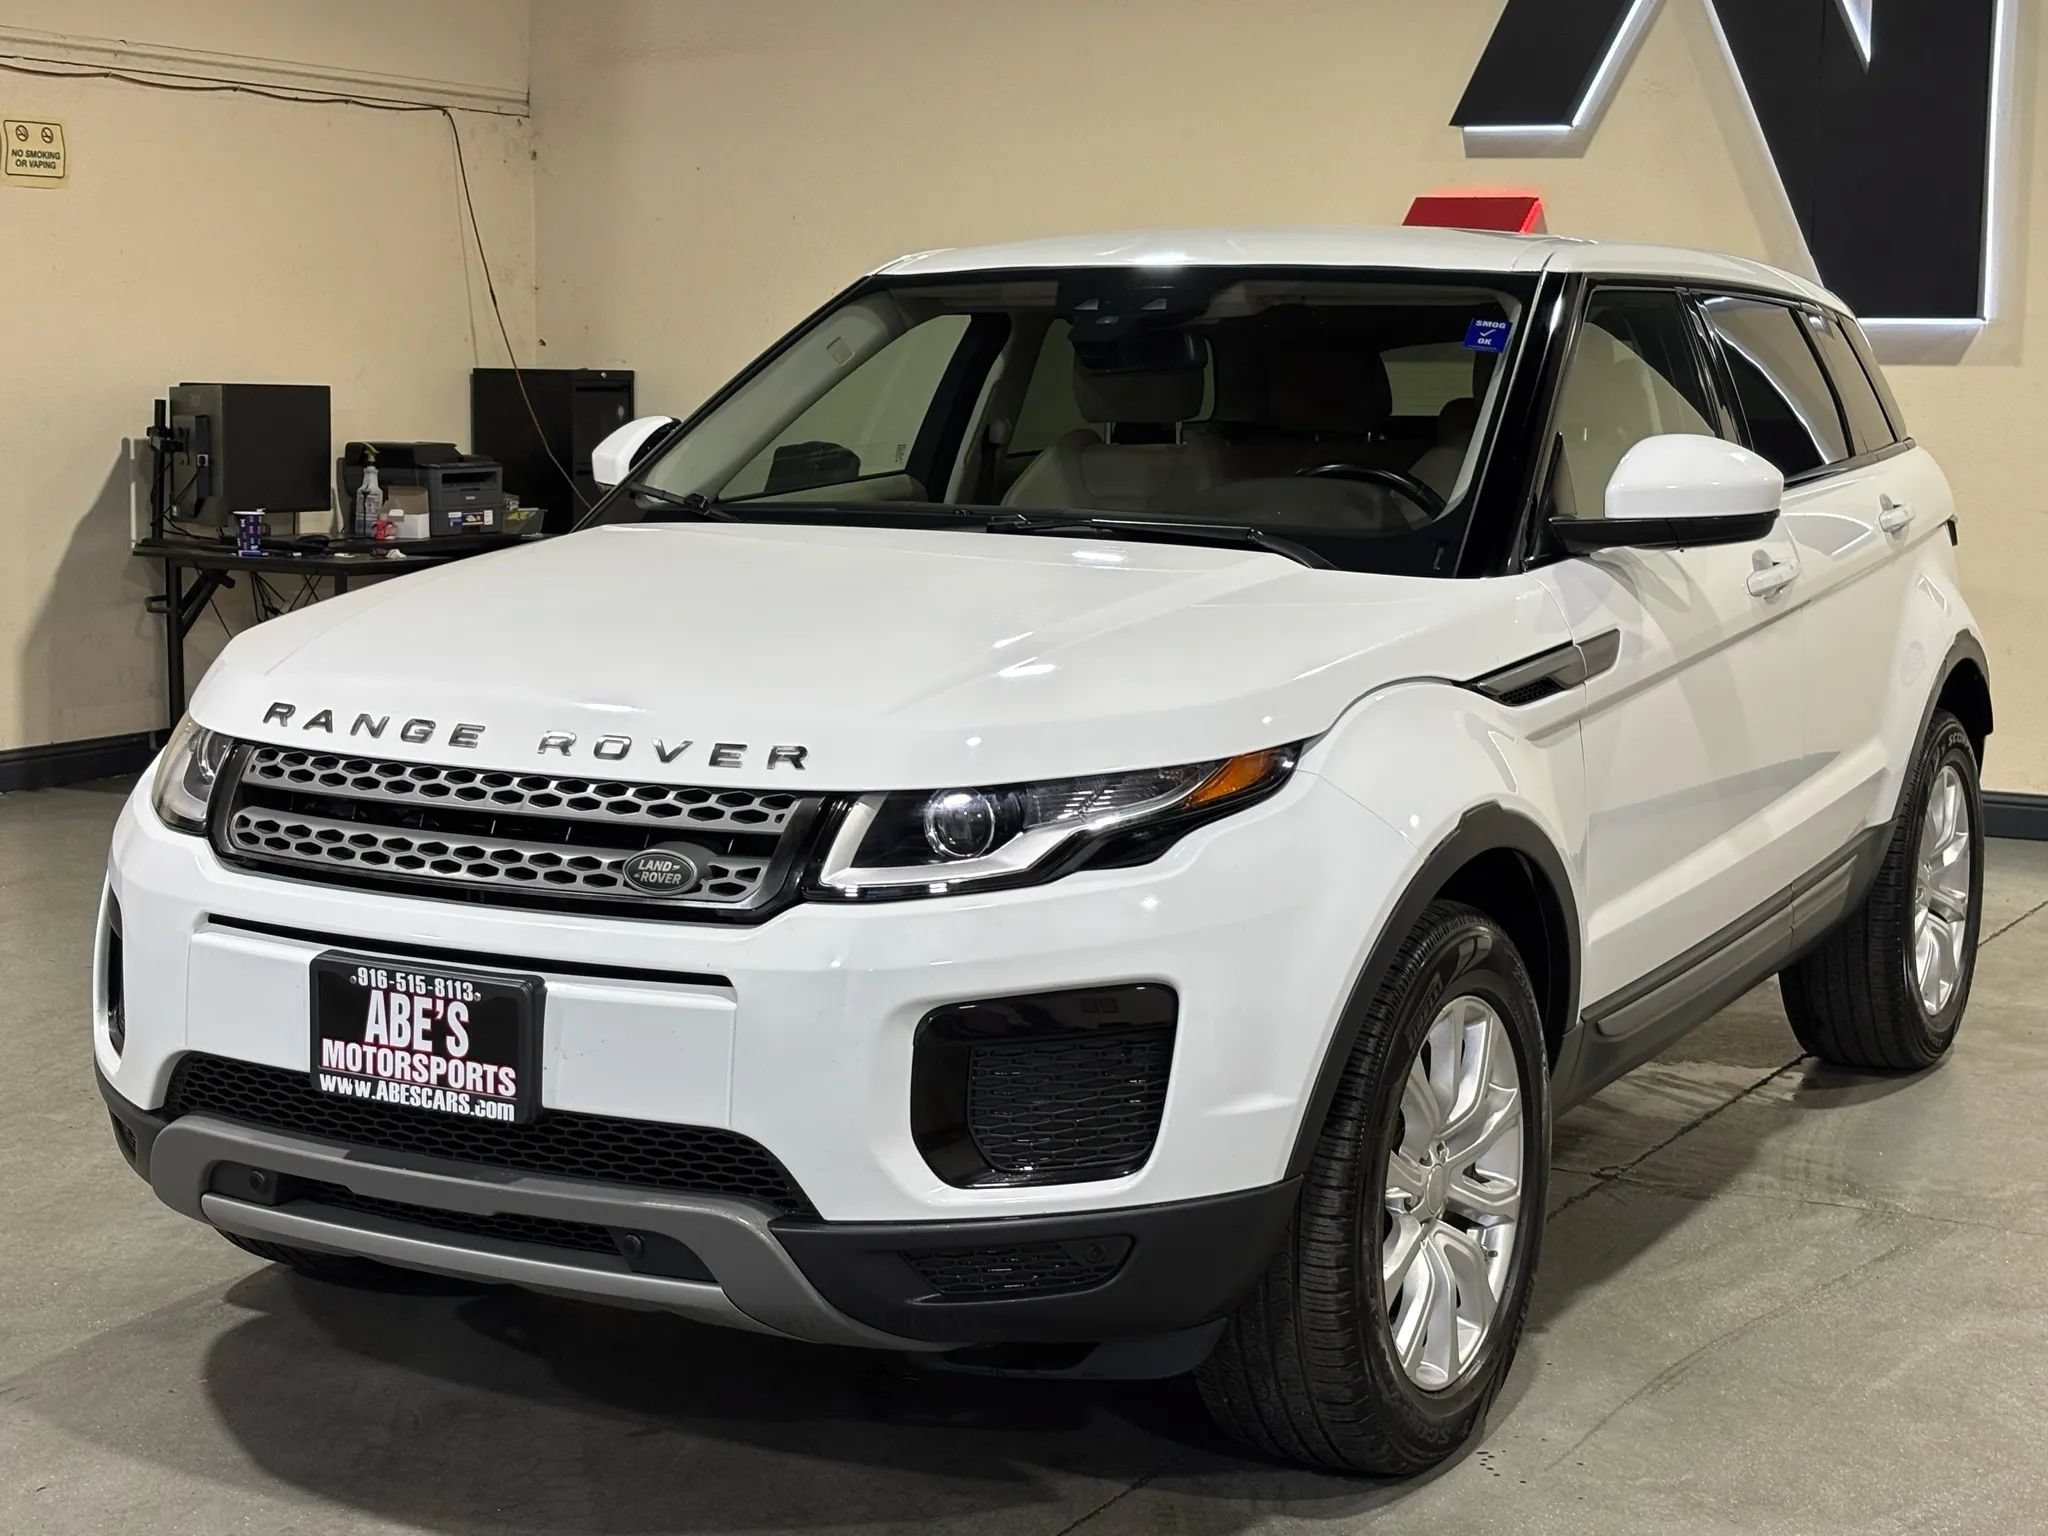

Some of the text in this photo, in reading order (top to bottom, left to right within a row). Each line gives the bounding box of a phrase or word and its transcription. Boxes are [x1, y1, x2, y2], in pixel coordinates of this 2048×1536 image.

[11, 149, 61, 160] NO SMOKING
[15, 159, 56, 169] OR VAPING
[1476, 320, 1506, 329] SMOG
[263, 702, 808, 770] RANGE ROVER
[357, 967, 474, 1001] 916-515-8113
[365, 990, 470, 1057] ABE'S
[321, 1038, 517, 1096] MOTORSPORTS
